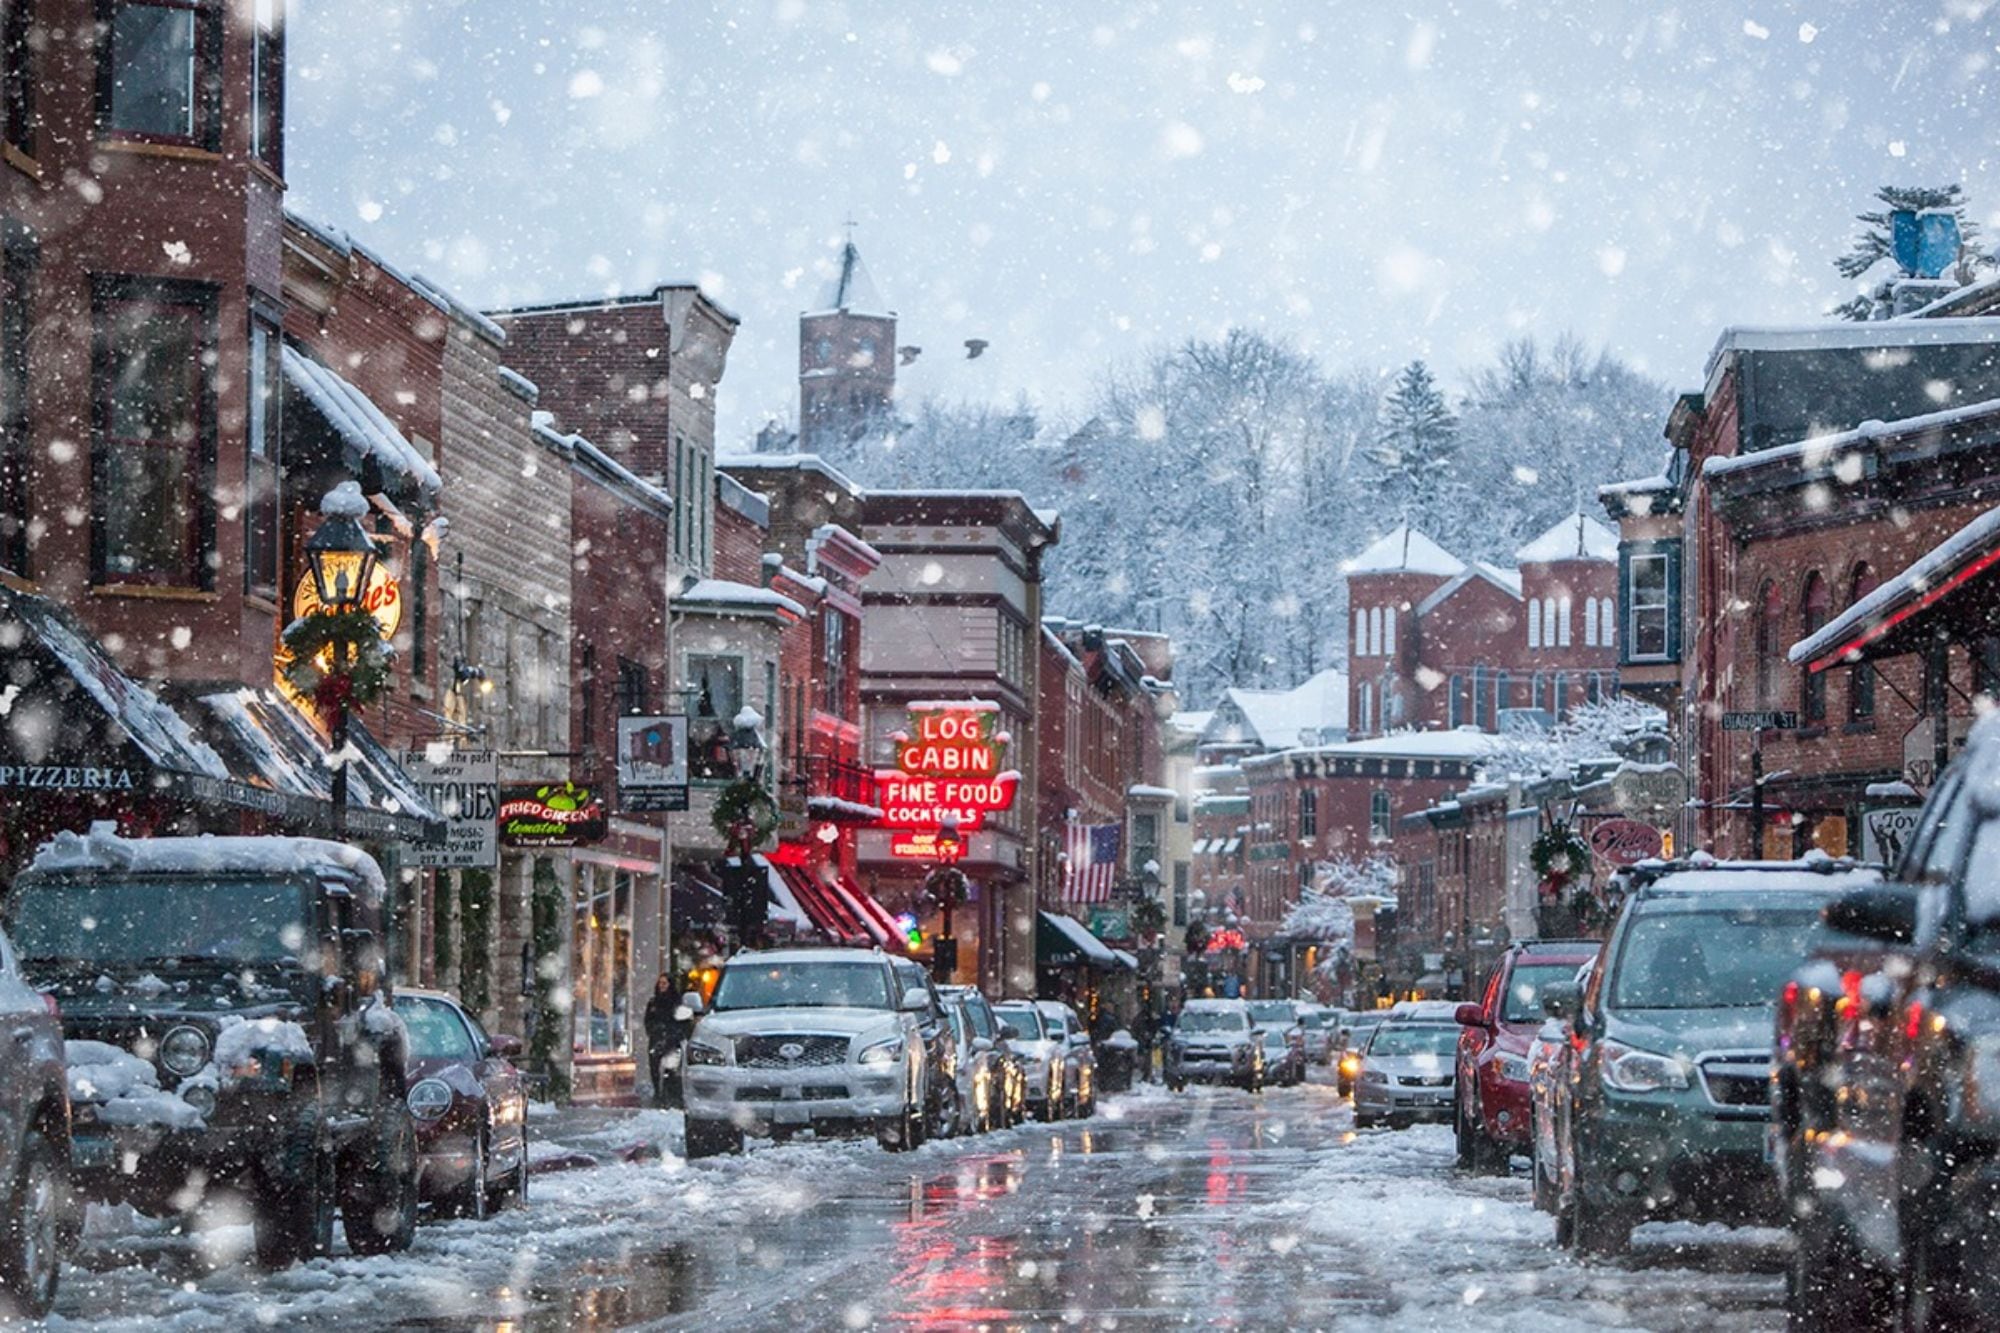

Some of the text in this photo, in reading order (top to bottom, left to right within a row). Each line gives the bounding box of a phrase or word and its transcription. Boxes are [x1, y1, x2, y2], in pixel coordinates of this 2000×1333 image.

[923, 716, 978, 739] LOG
[1723, 712, 1795, 729] DIAGONAL ST
[904, 747, 989, 770] CABIN
[0, 765, 134, 789] PIZZERIA
[887, 783, 1004, 804] FINE FOOD
[500, 801, 590, 822] FRIED GREEN
